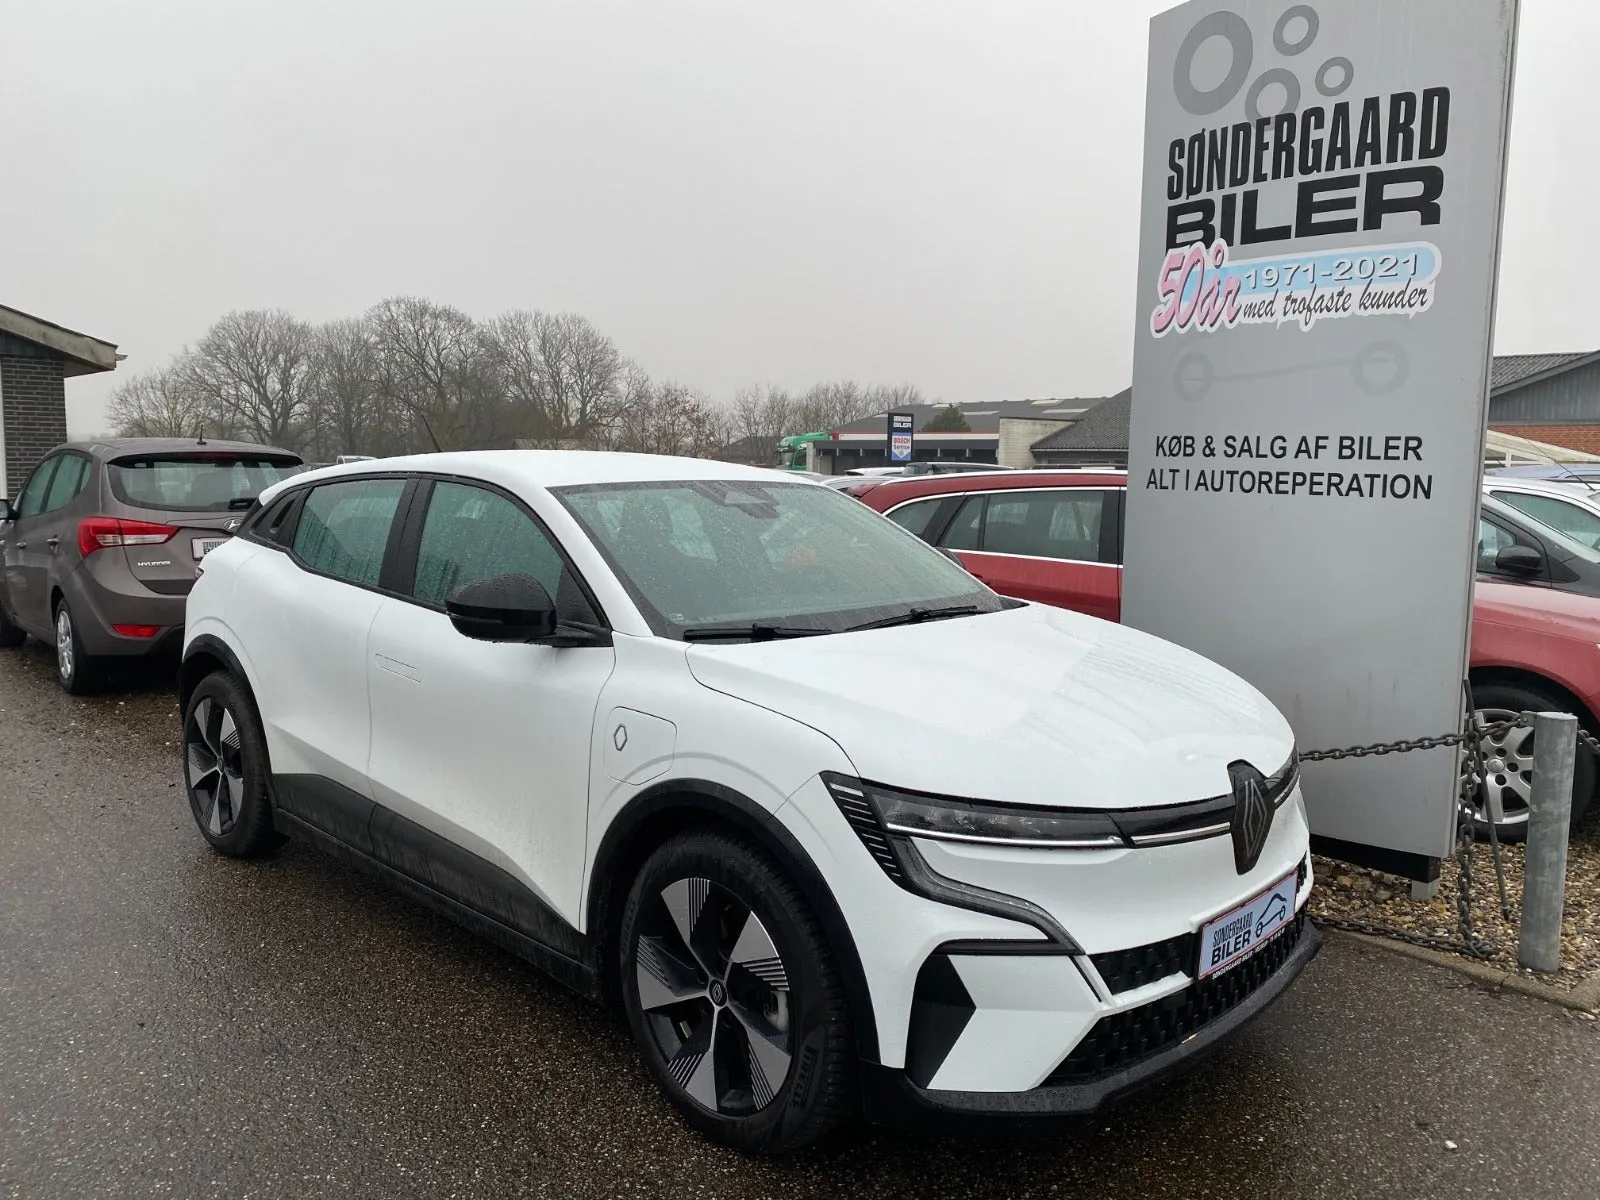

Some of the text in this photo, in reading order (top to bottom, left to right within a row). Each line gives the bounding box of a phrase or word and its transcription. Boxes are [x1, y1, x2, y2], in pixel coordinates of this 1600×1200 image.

[1167, 86, 1451, 201] SØNDERGAARD
[1165, 165, 1444, 257] BILER
[1245, 252, 1417, 289] 1971-2021
[1243, 277, 1428, 326] med trofaste kunder
[1155, 434, 1423, 461] KØB & SALG AF BILER
[1146, 468, 1433, 500] ALT I AUTOREPERATION
[1211, 929, 1251, 967] BILER
